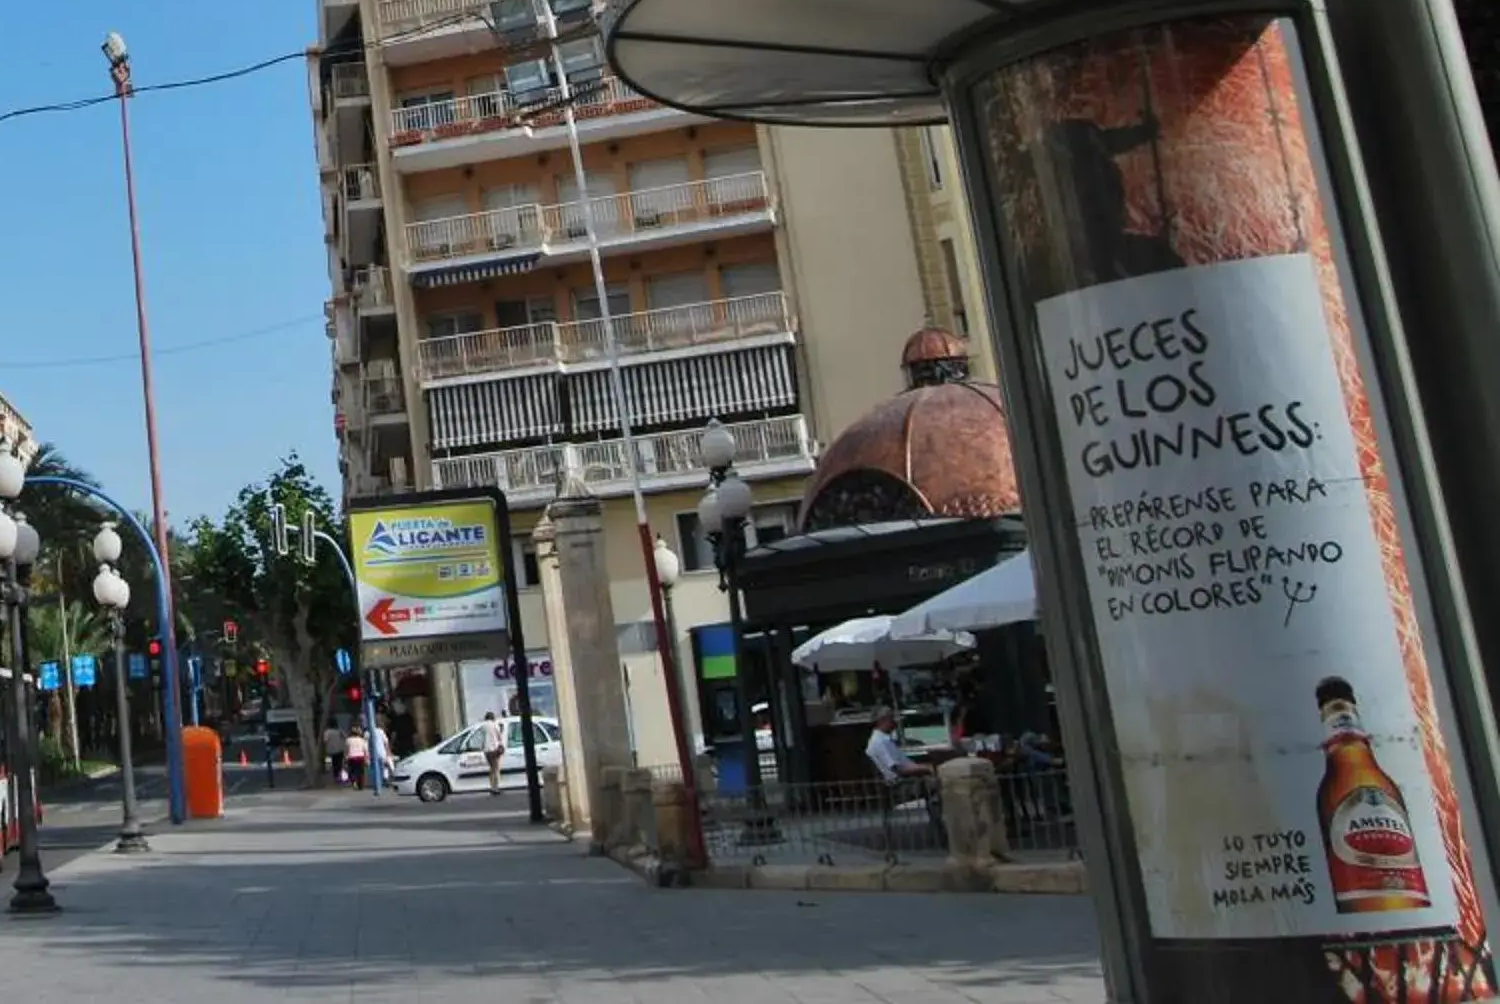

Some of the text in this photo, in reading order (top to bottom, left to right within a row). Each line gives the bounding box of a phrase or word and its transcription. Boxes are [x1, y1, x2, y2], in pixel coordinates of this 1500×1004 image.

[1064, 309, 1209, 380] JUECES
[1070, 361, 1217, 427] DE LOS
[1081, 401, 1323, 478] GUINNESS:
[1089, 476, 1328, 531] PREPÁRENSE PARA
[1096, 535, 1121, 562] EL
[1238, 514, 1268, 540] DE
[1208, 540, 1344, 578] FLIPANDO
[1107, 595, 1135, 622] EN
[1251, 828, 1306, 853] TUYO
[1224, 852, 1312, 881] SIEMPRE
[1212, 885, 1265, 908] MOLA
